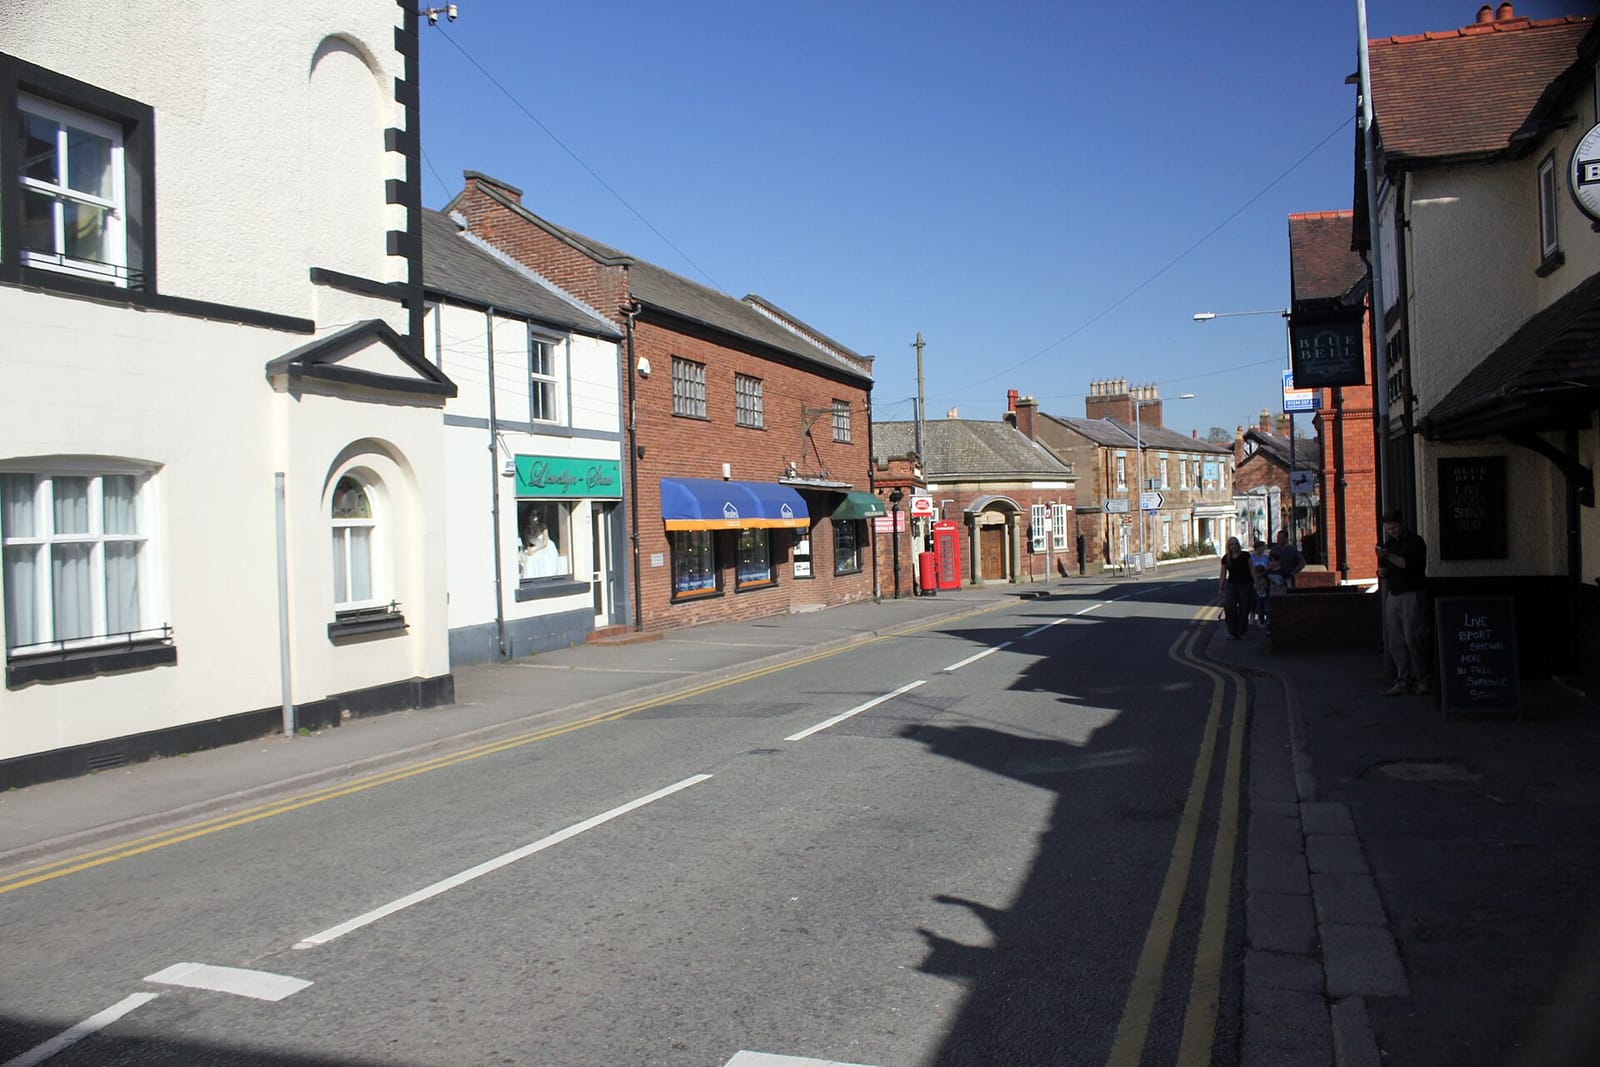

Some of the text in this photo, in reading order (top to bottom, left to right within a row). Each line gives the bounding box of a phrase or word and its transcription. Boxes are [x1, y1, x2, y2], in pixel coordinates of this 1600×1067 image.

[1299, 335, 1356, 349] BLUE
[1301, 347, 1356, 360] BELL
[1464, 612, 1488, 627] LIVE
[1458, 629, 1492, 641] SPORT
[1469, 642, 1504, 652] SHOWN
